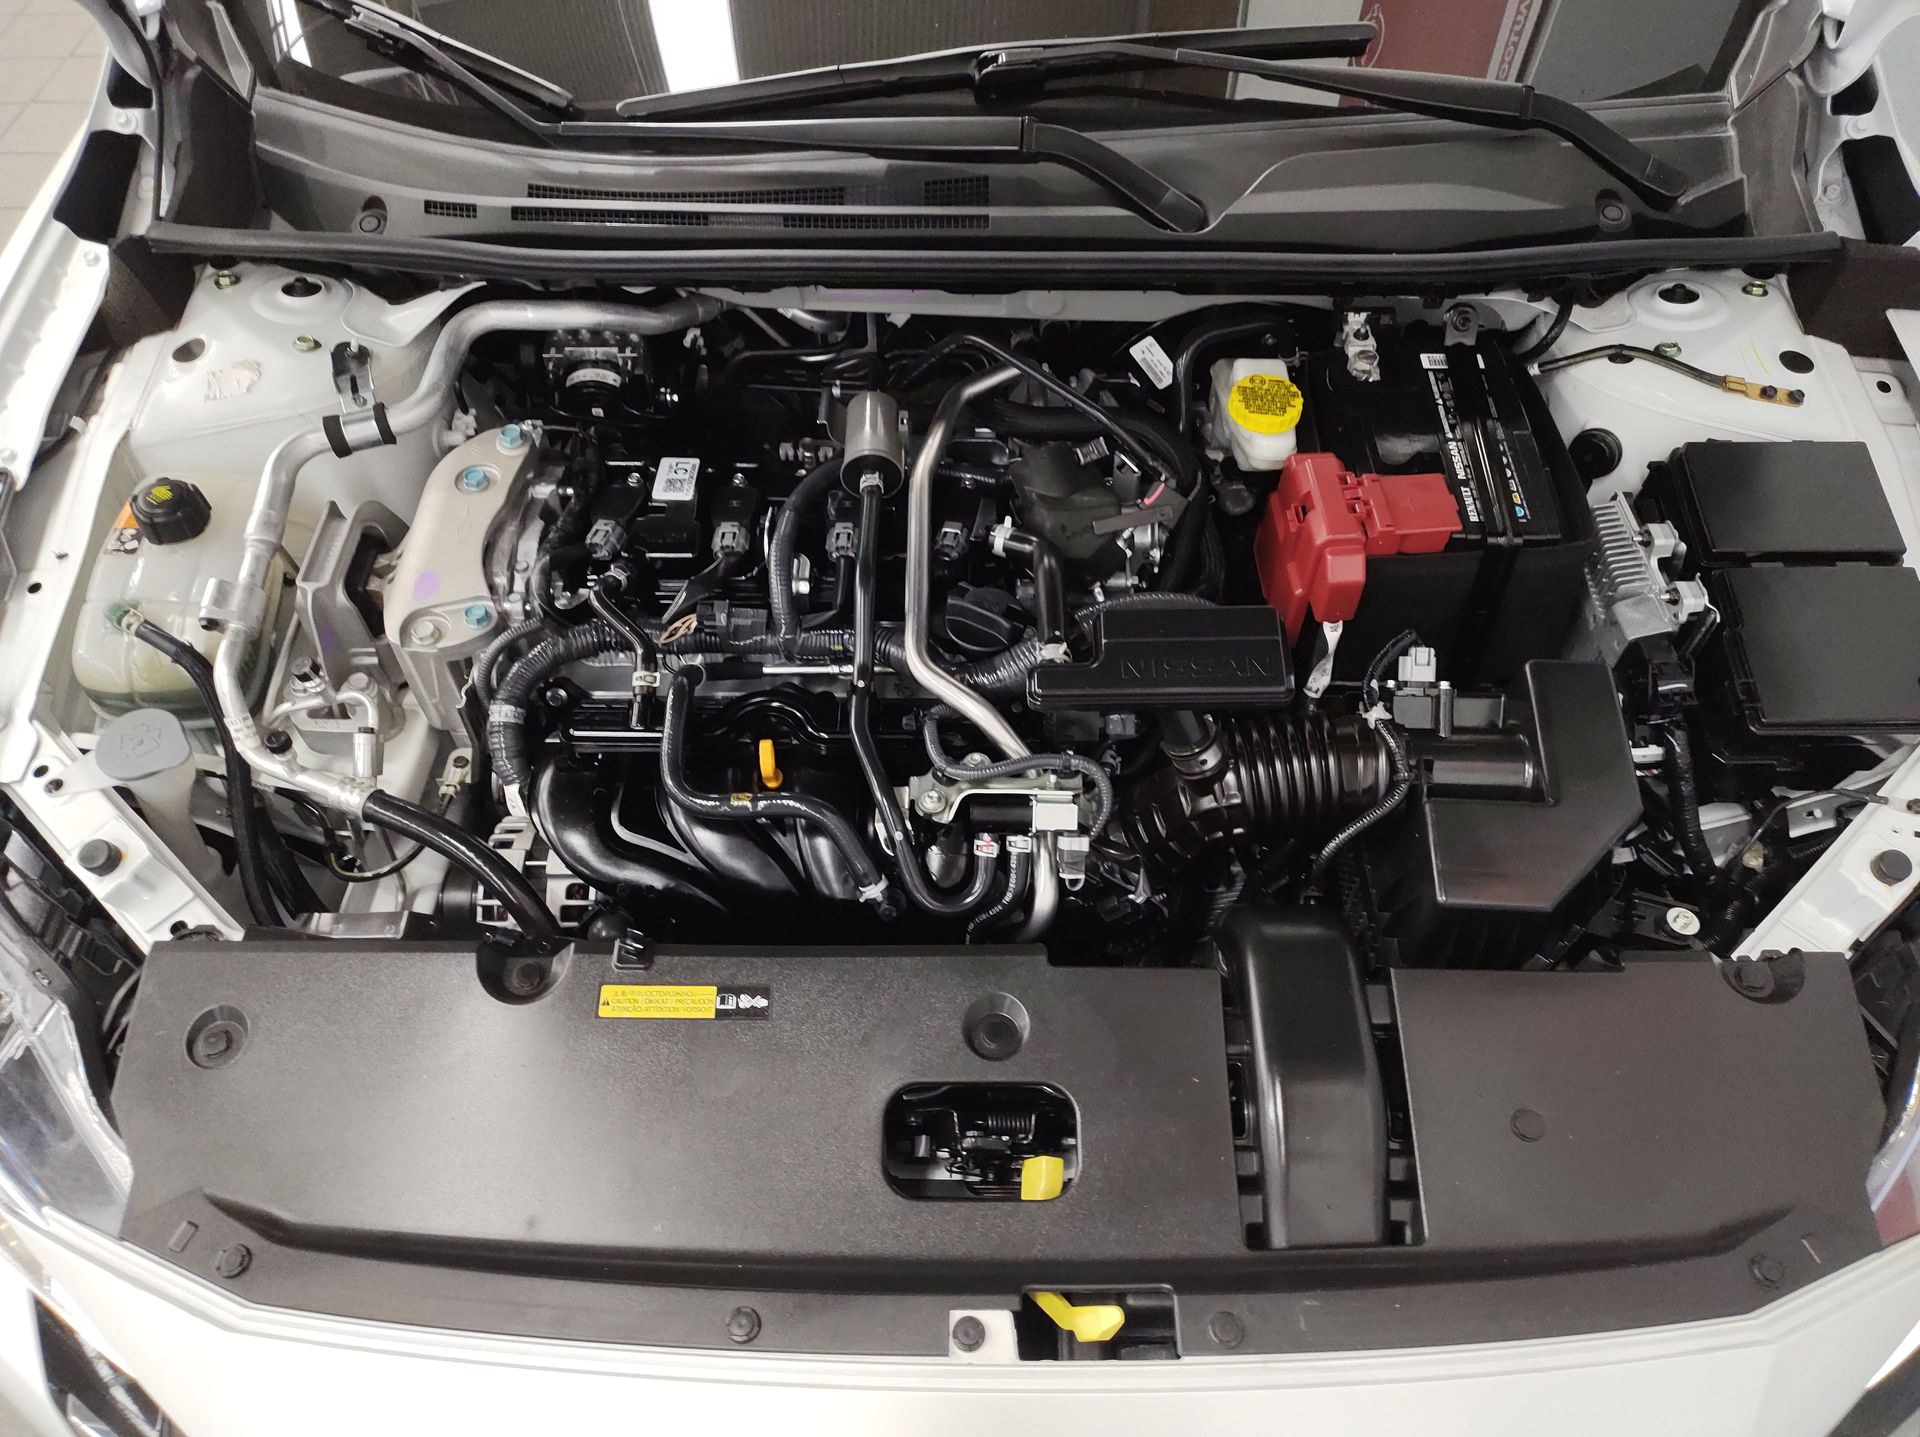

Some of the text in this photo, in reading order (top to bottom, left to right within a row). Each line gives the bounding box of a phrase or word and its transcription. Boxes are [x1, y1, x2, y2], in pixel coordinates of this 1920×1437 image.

[674, 461, 690, 475] LC
[1448, 441, 1466, 480] NISSAN
[1461, 486, 1479, 522] RENAULT
[1120, 656, 1276, 678] NISSAN
